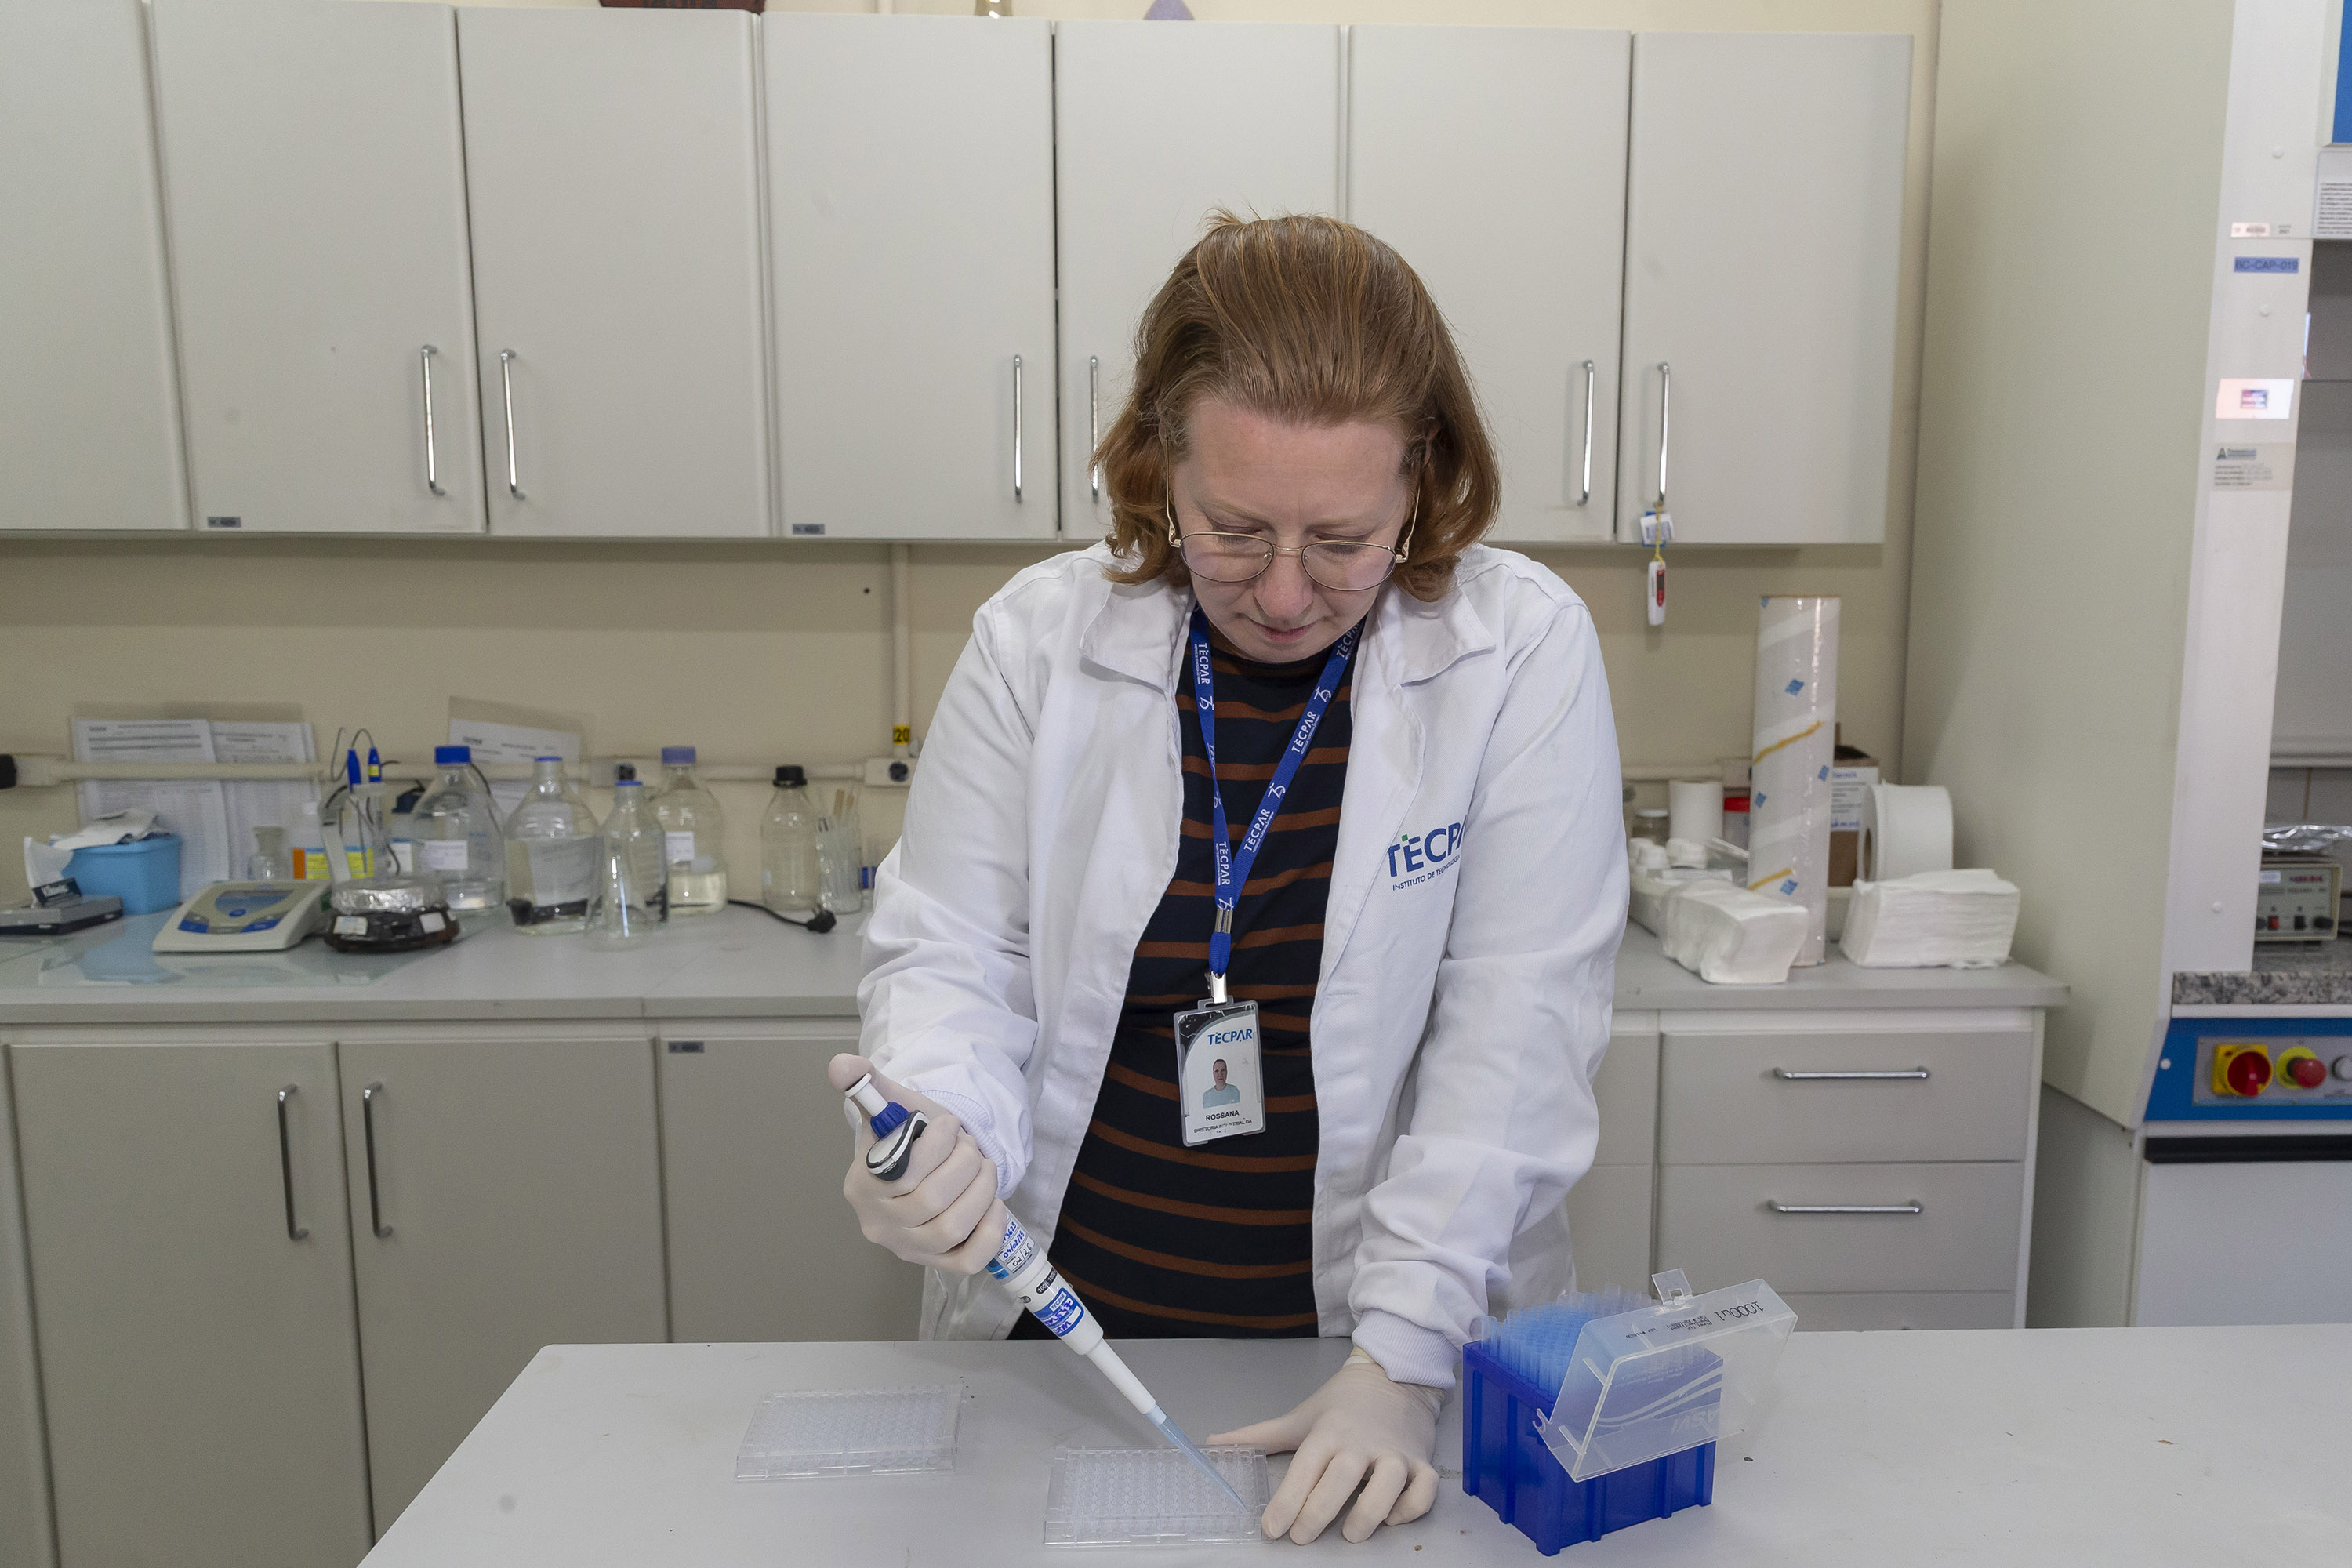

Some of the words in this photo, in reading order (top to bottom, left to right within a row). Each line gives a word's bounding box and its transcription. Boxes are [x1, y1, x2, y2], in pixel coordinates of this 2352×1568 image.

[1198, 642, 1210, 684] TECPAR
[1291, 710, 1317, 754] TECPAR
[1243, 808, 1271, 852] TECPAR
[1218, 840, 1231, 886] TECPAR
[1392, 875, 1426, 891] INSTITUTO
[1427, 871, 1436, 880] DE
[1207, 1028, 1254, 1045] TECPAR
[1193, 1124, 1218, 1134] DIRETORIA
[1205, 1109, 1240, 1122] ROSSANA
